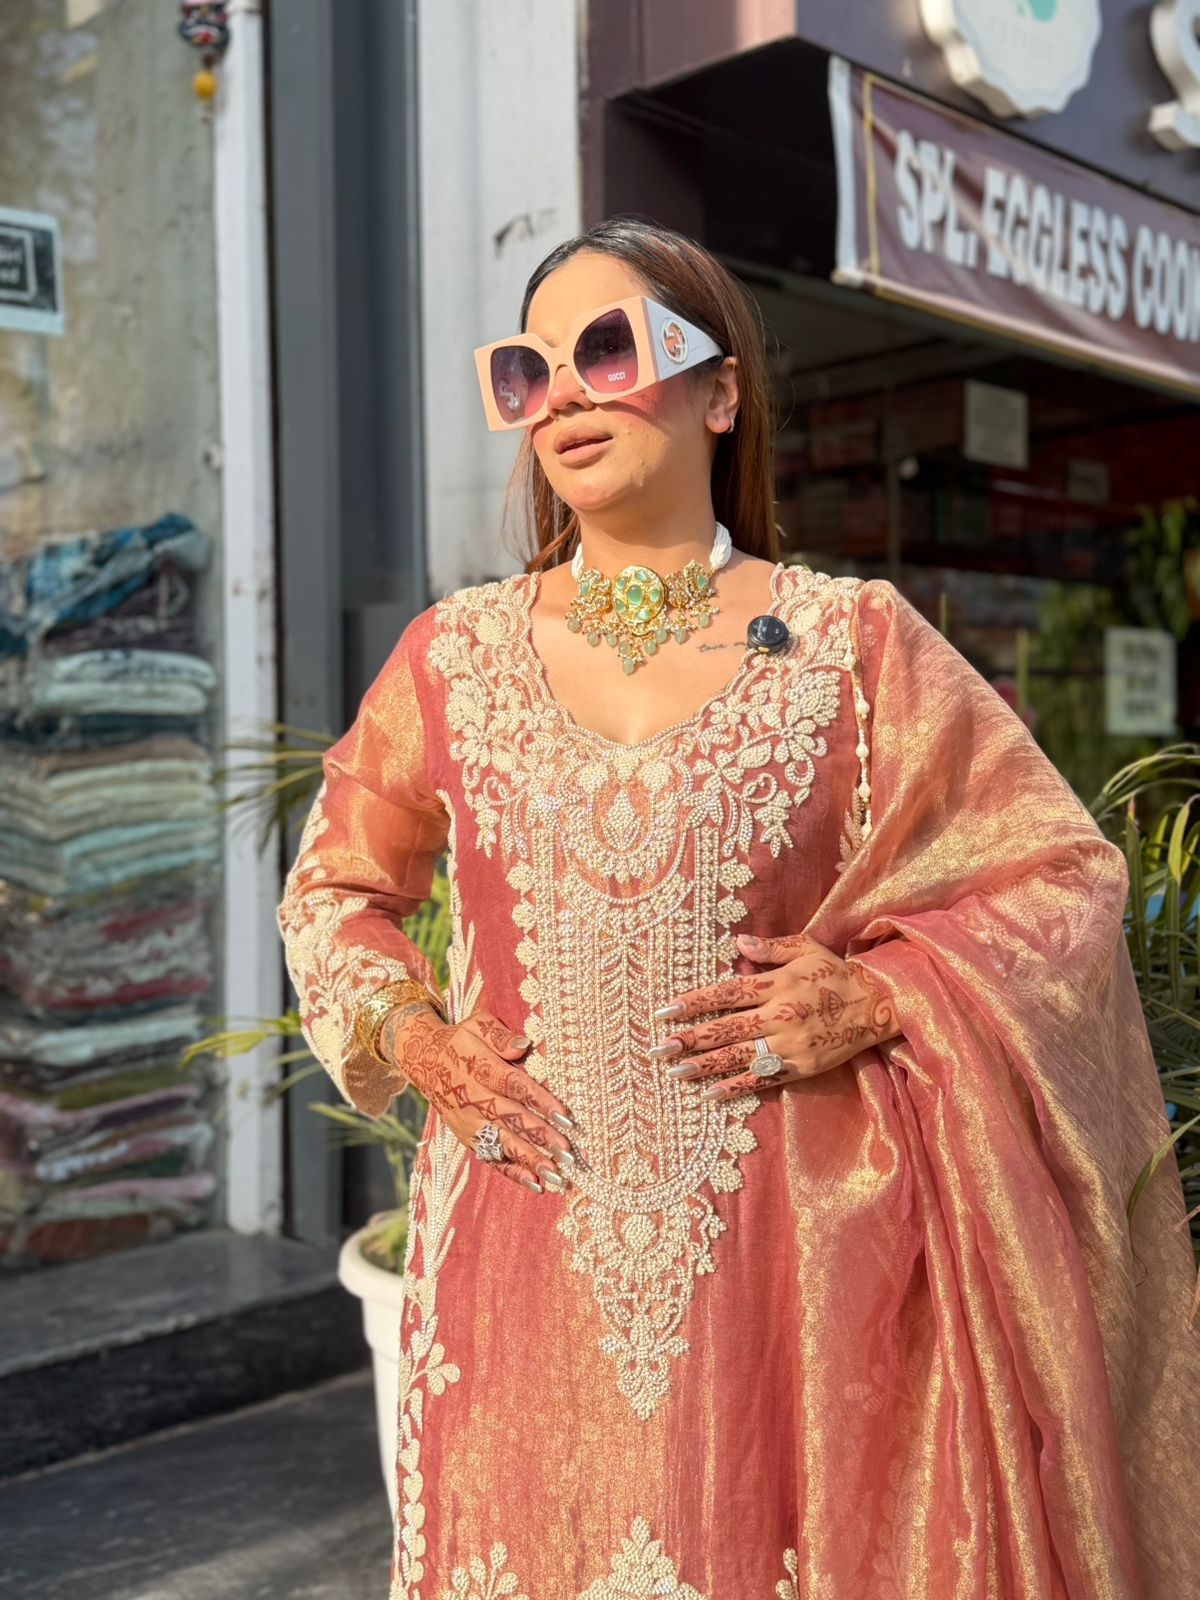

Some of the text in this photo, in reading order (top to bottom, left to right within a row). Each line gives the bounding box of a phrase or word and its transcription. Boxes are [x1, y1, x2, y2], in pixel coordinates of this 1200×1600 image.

[896, 129, 977, 267] SPL.
[983, 166, 1127, 320] EGGLESS
[607, 371, 626, 382] GUCCI
